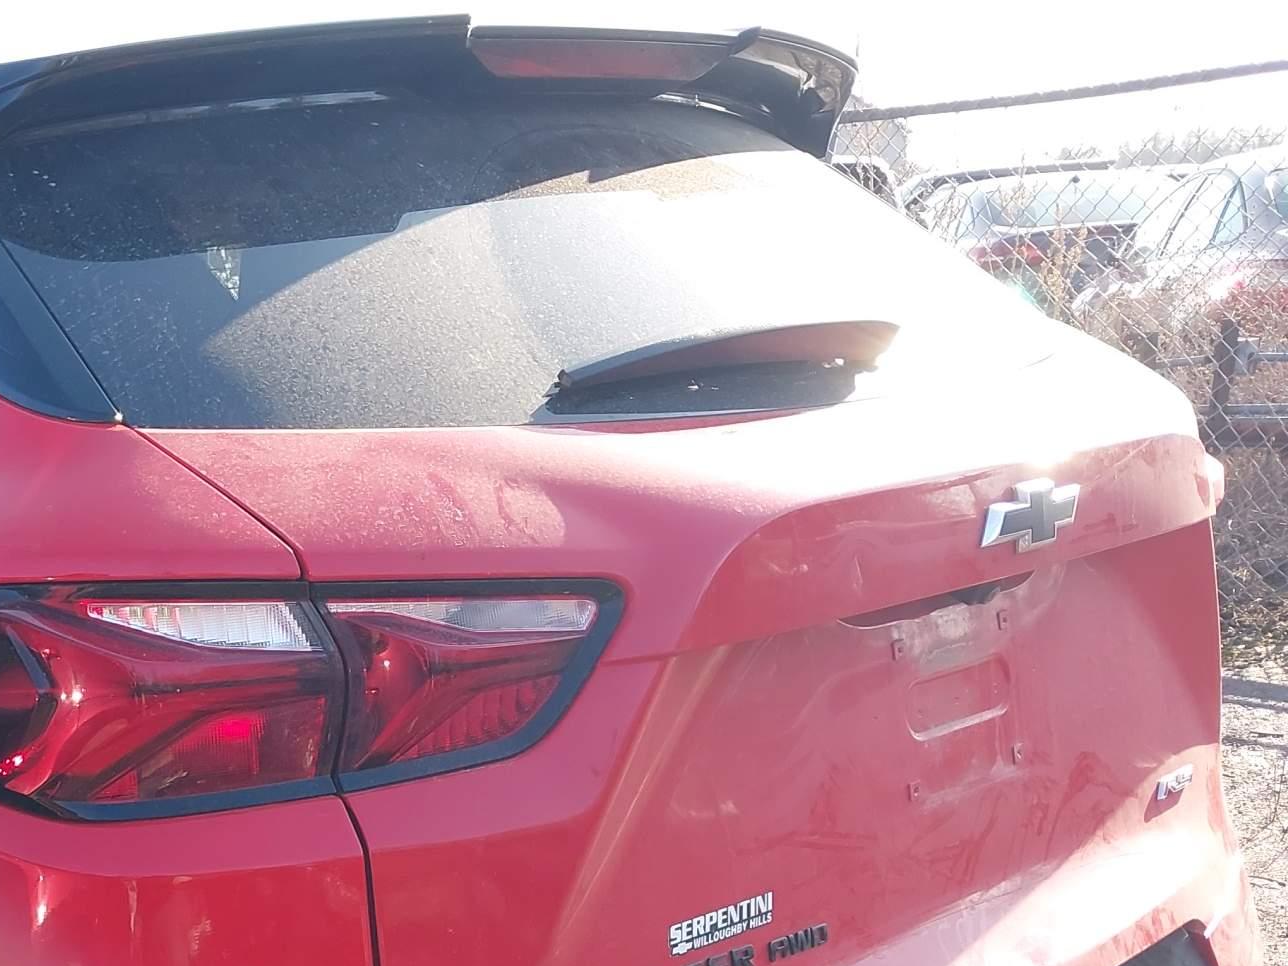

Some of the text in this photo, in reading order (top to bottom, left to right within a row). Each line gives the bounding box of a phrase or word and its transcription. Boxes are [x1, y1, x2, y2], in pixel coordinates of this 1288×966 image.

[670, 891, 773, 945] SERPENTINI
[693, 912, 773, 949] WILLOUGHBY HILLS
[768, 923, 828, 962] AWD
